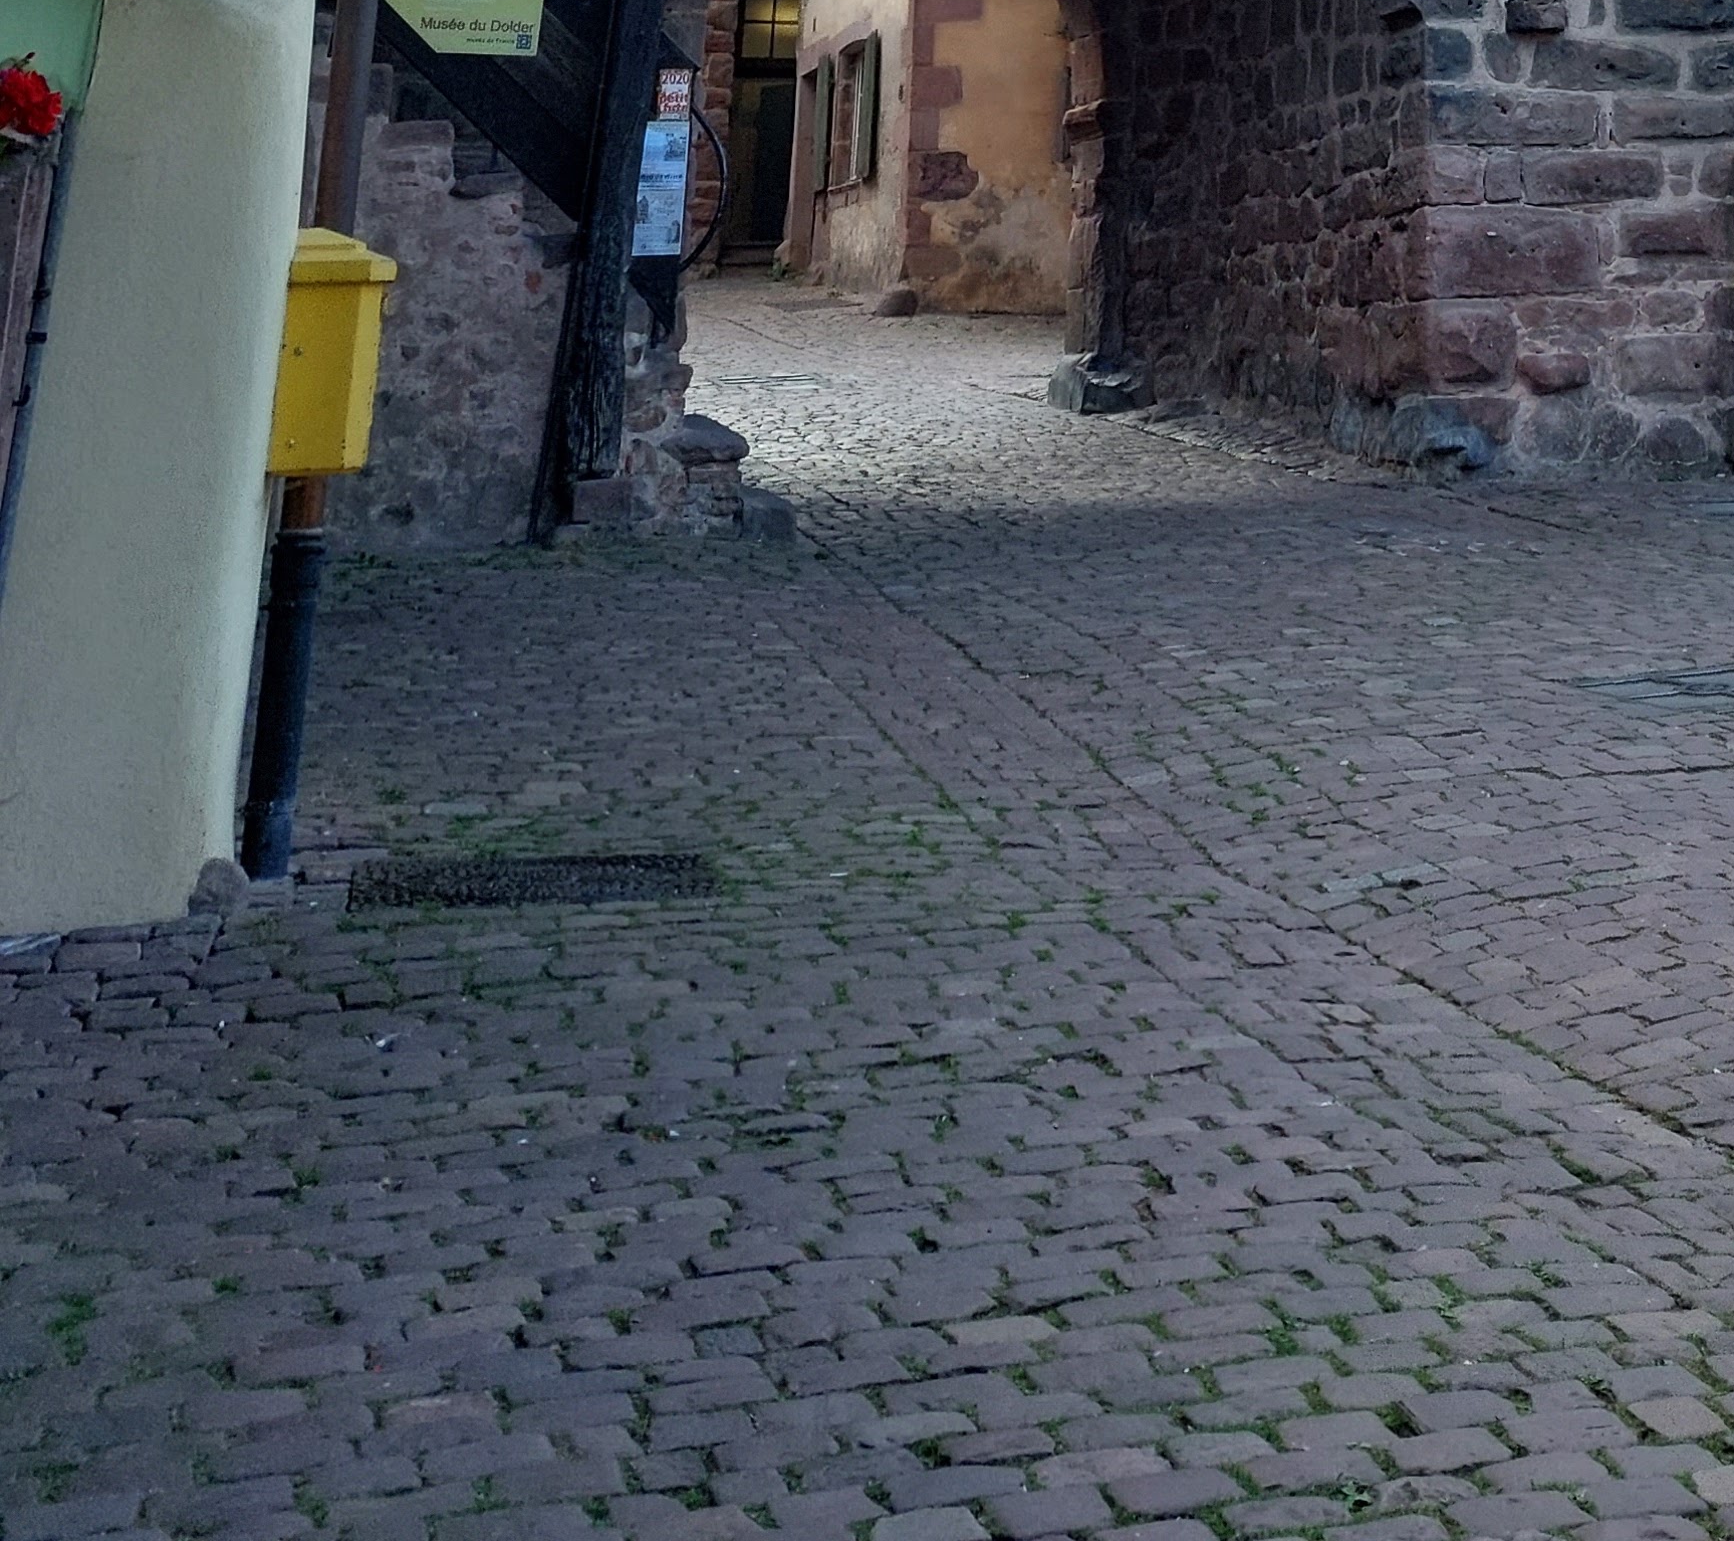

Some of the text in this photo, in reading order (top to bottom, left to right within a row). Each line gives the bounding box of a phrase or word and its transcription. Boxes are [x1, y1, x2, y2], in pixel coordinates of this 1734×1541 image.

[420, 16, 535, 34] Musée du Dolder
[661, 73, 690, 85] 2020
